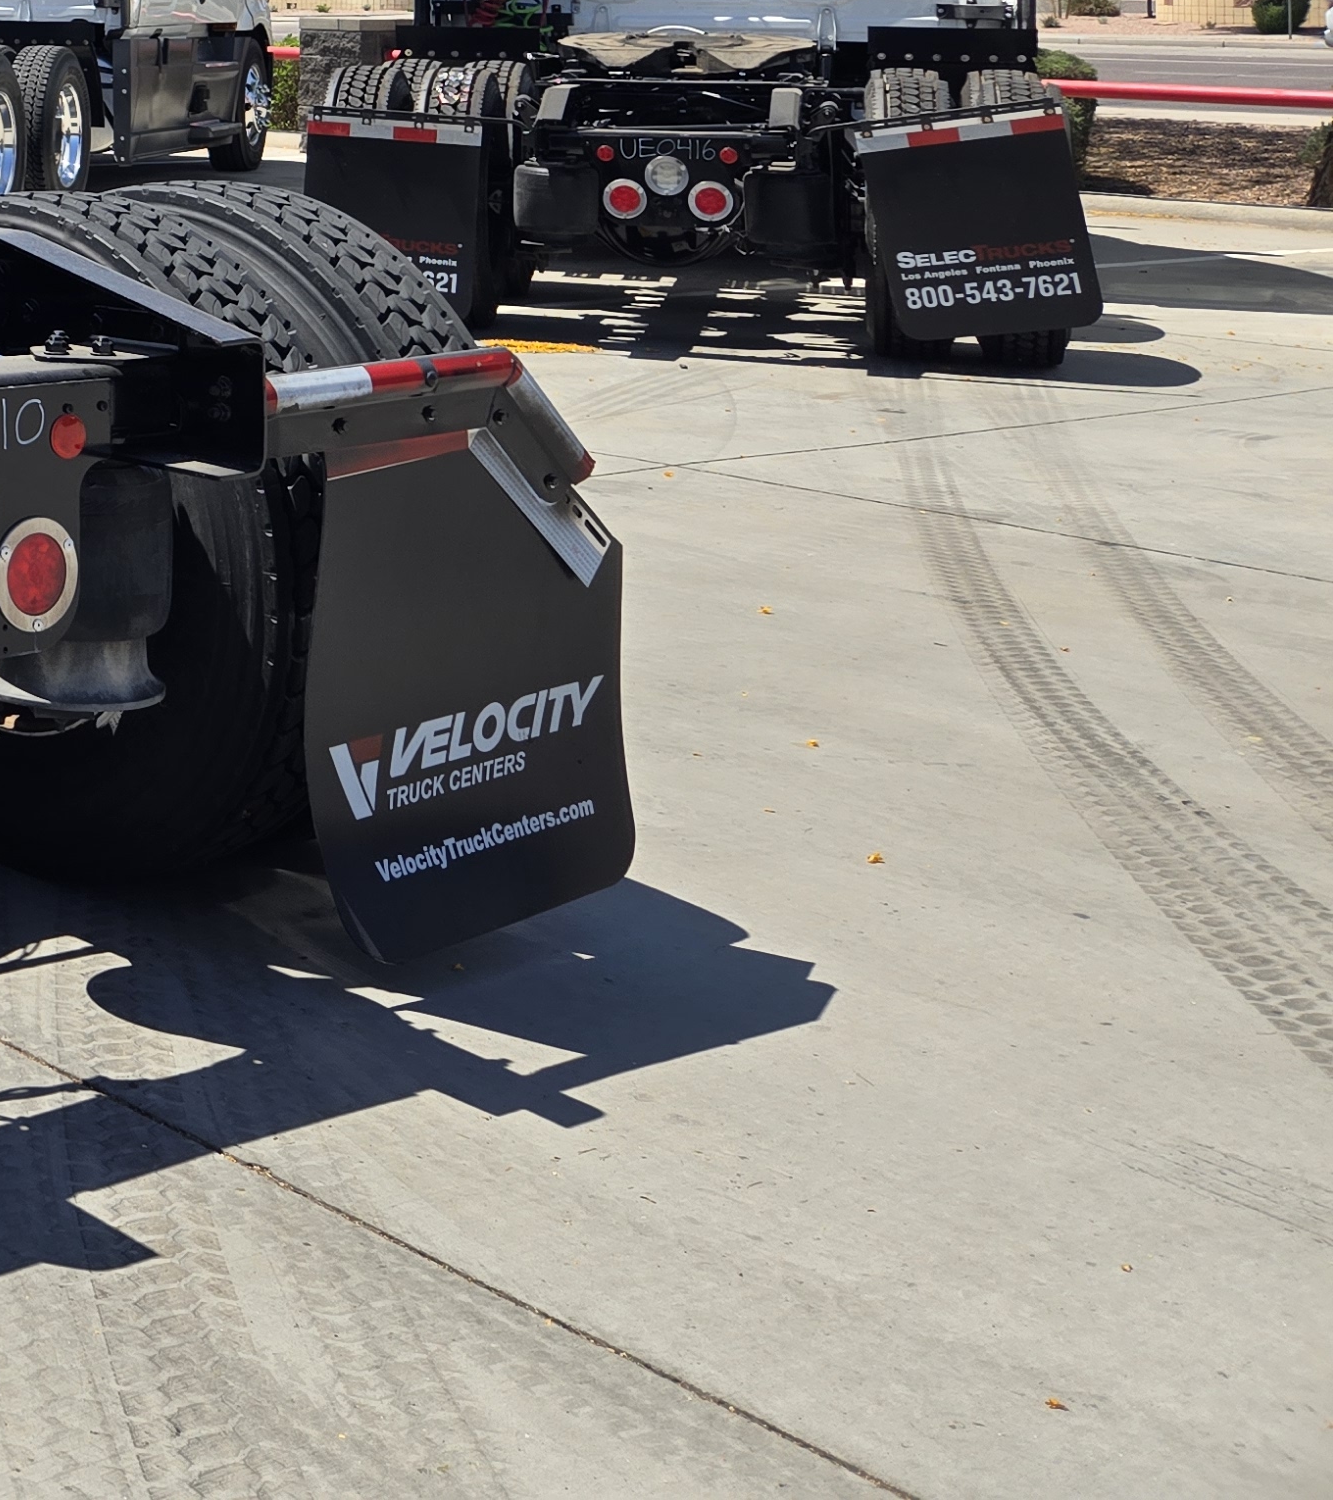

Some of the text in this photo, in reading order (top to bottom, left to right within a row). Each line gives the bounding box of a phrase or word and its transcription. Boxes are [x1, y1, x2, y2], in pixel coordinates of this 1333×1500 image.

[619, 138, 717, 161] UE0416
[419, 256, 458, 267] Phoenix
[896, 240, 1073, 269] SELECTRUCKS
[900, 257, 1075, 281] Los Angeles Fontana Phoenix
[904, 272, 1083, 310] 800-543-7621
[389, 674, 604, 778] VELOCITY
[386, 751, 526, 811] TRUCK CENTERS
[374, 799, 595, 883] VelocityTruckCenters.com
